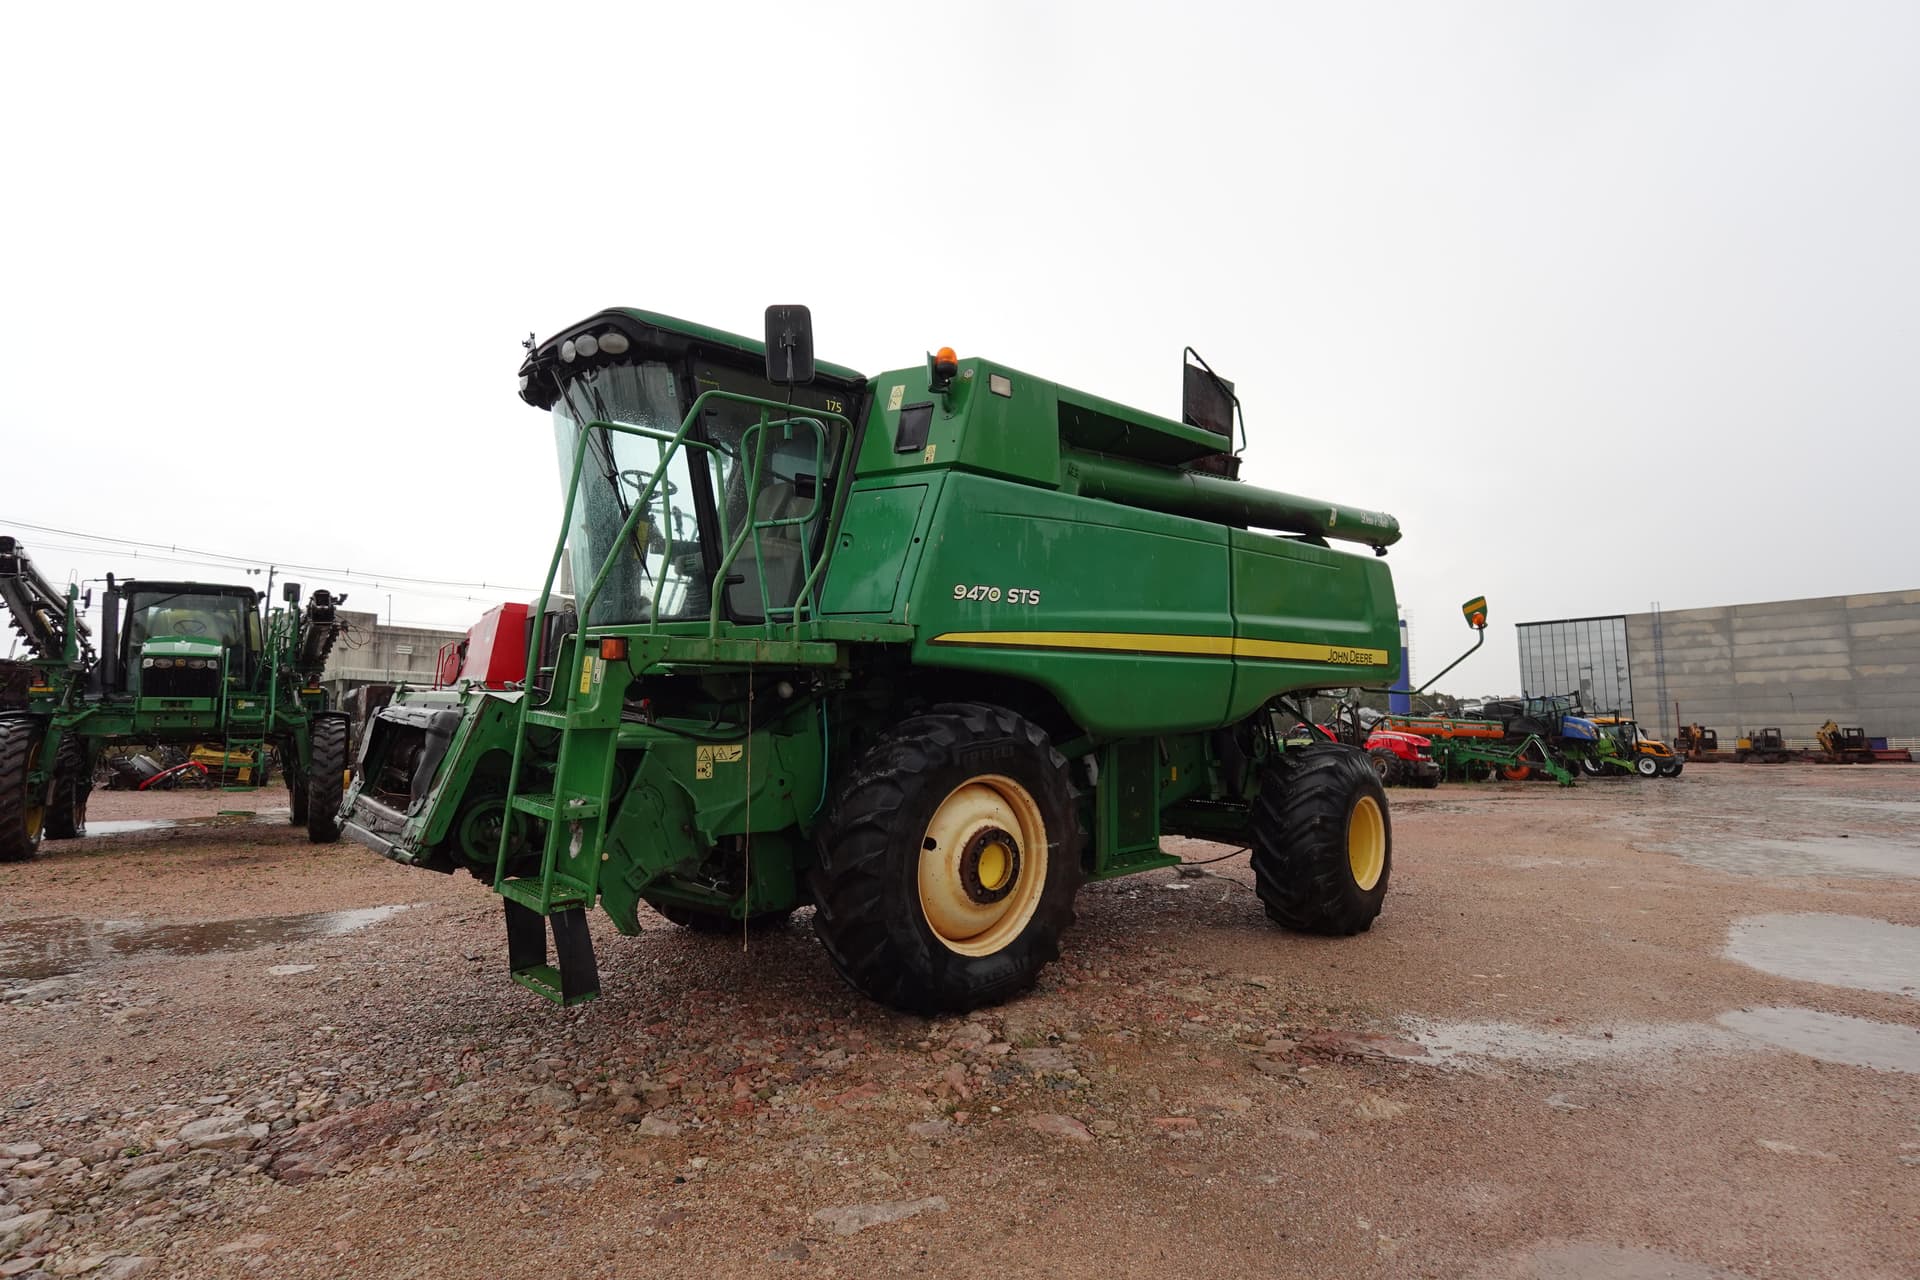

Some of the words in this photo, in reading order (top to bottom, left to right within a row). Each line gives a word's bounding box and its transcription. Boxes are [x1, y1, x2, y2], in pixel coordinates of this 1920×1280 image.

[826, 399, 842, 413] 175
[953, 584, 1001, 602] 9470
[1007, 588, 1041, 605] STS
[1327, 648, 1349, 662] JOHN
[1350, 649, 1373, 664] DEERE
